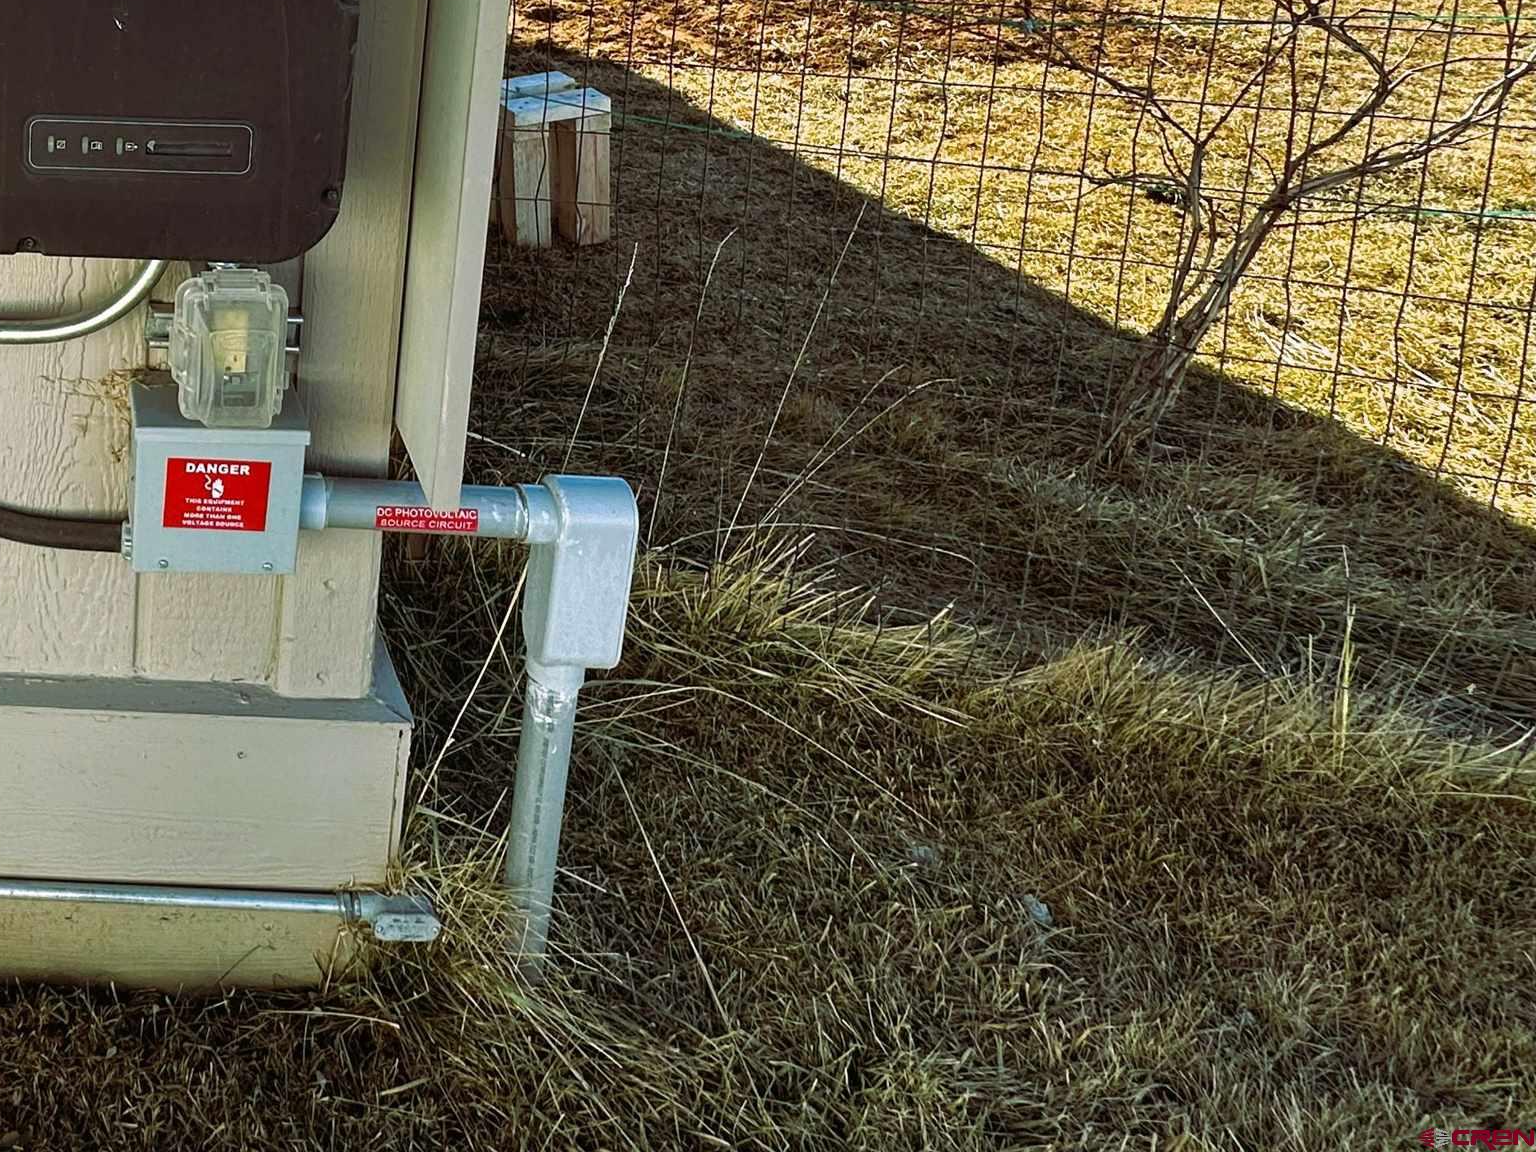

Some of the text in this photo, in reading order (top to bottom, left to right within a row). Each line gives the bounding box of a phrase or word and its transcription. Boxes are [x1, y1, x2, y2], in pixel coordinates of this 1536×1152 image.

[185, 462, 250, 476] DANGER
[203, 498, 244, 506] EQUIPMENT
[376, 507, 477, 520] DC PHOTOVOLTAIC
[182, 519, 244, 528] VOLTAGE SOURCE
[380, 518, 473, 530] SOURCE CIRCUIT
